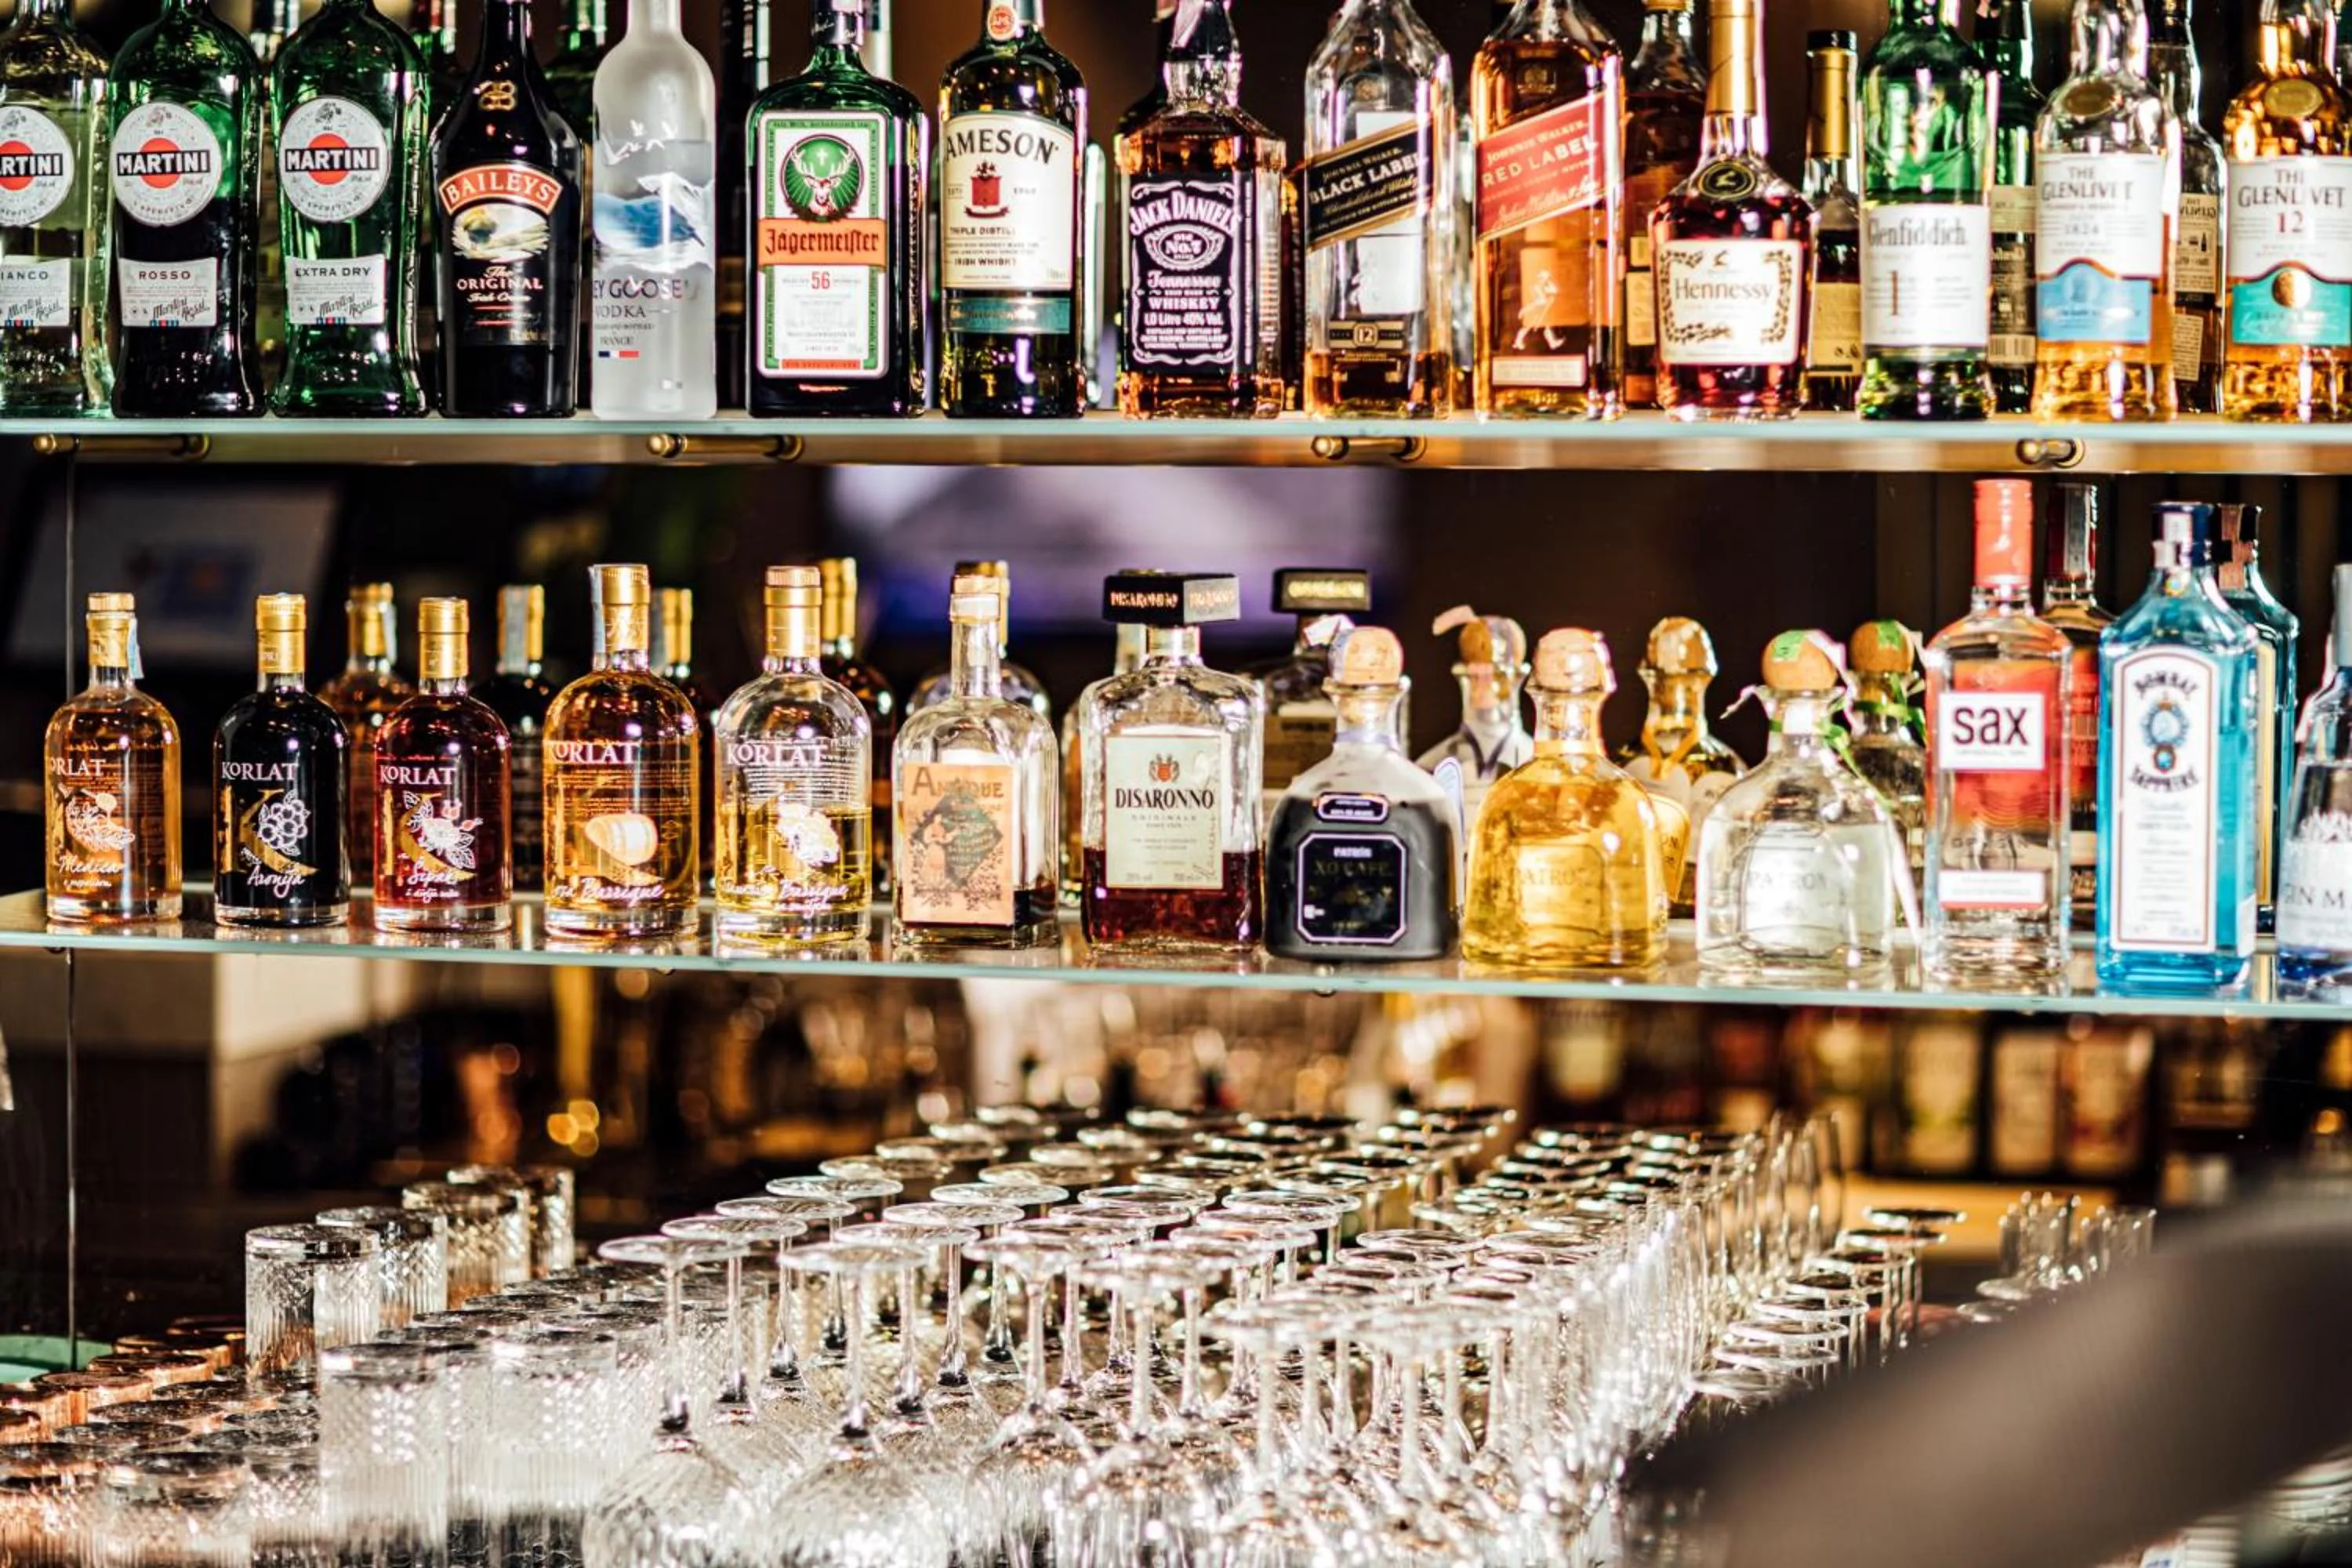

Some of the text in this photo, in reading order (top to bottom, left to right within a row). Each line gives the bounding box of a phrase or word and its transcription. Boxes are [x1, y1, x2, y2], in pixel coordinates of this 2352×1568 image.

[946, 129, 1054, 164] AMESON
[0, 154, 60, 175] RTINI
[119, 152, 208, 174] MARTINI
[287, 149, 376, 170] MARTINI
[1482, 162, 1523, 188] RED
[1529, 136, 1597, 169] LABEL
[2068, 166, 2095, 179] THE
[446, 172, 552, 204] BAILEYS
[1309, 173, 1365, 203] BLACK
[2238, 186, 2346, 208] GLENLVET
[1129, 198, 1169, 235] JACK
[2278, 212, 2303, 233] 12
[139, 270, 191, 280] ROSSO
[296, 267, 371, 277] EXTRA DRY
[811, 271, 830, 290] 56
[456, 278, 543, 291] ORIGINAL
[609, 278, 683, 299] GOOSE
[1675, 278, 1773, 305] Hennessy
[597, 305, 646, 318] ODKA
[1148, 297, 1220, 310] WHISKEY
[1359, 328, 1373, 343] 12
[1953, 708, 2028, 746] sax
[49, 757, 107, 777] ORLAT
[221, 761, 301, 781] KORLAT
[379, 764, 458, 785] KORLAT
[911, 766, 1004, 799] ANQUE
[1116, 788, 1214, 810] DISARONNO
